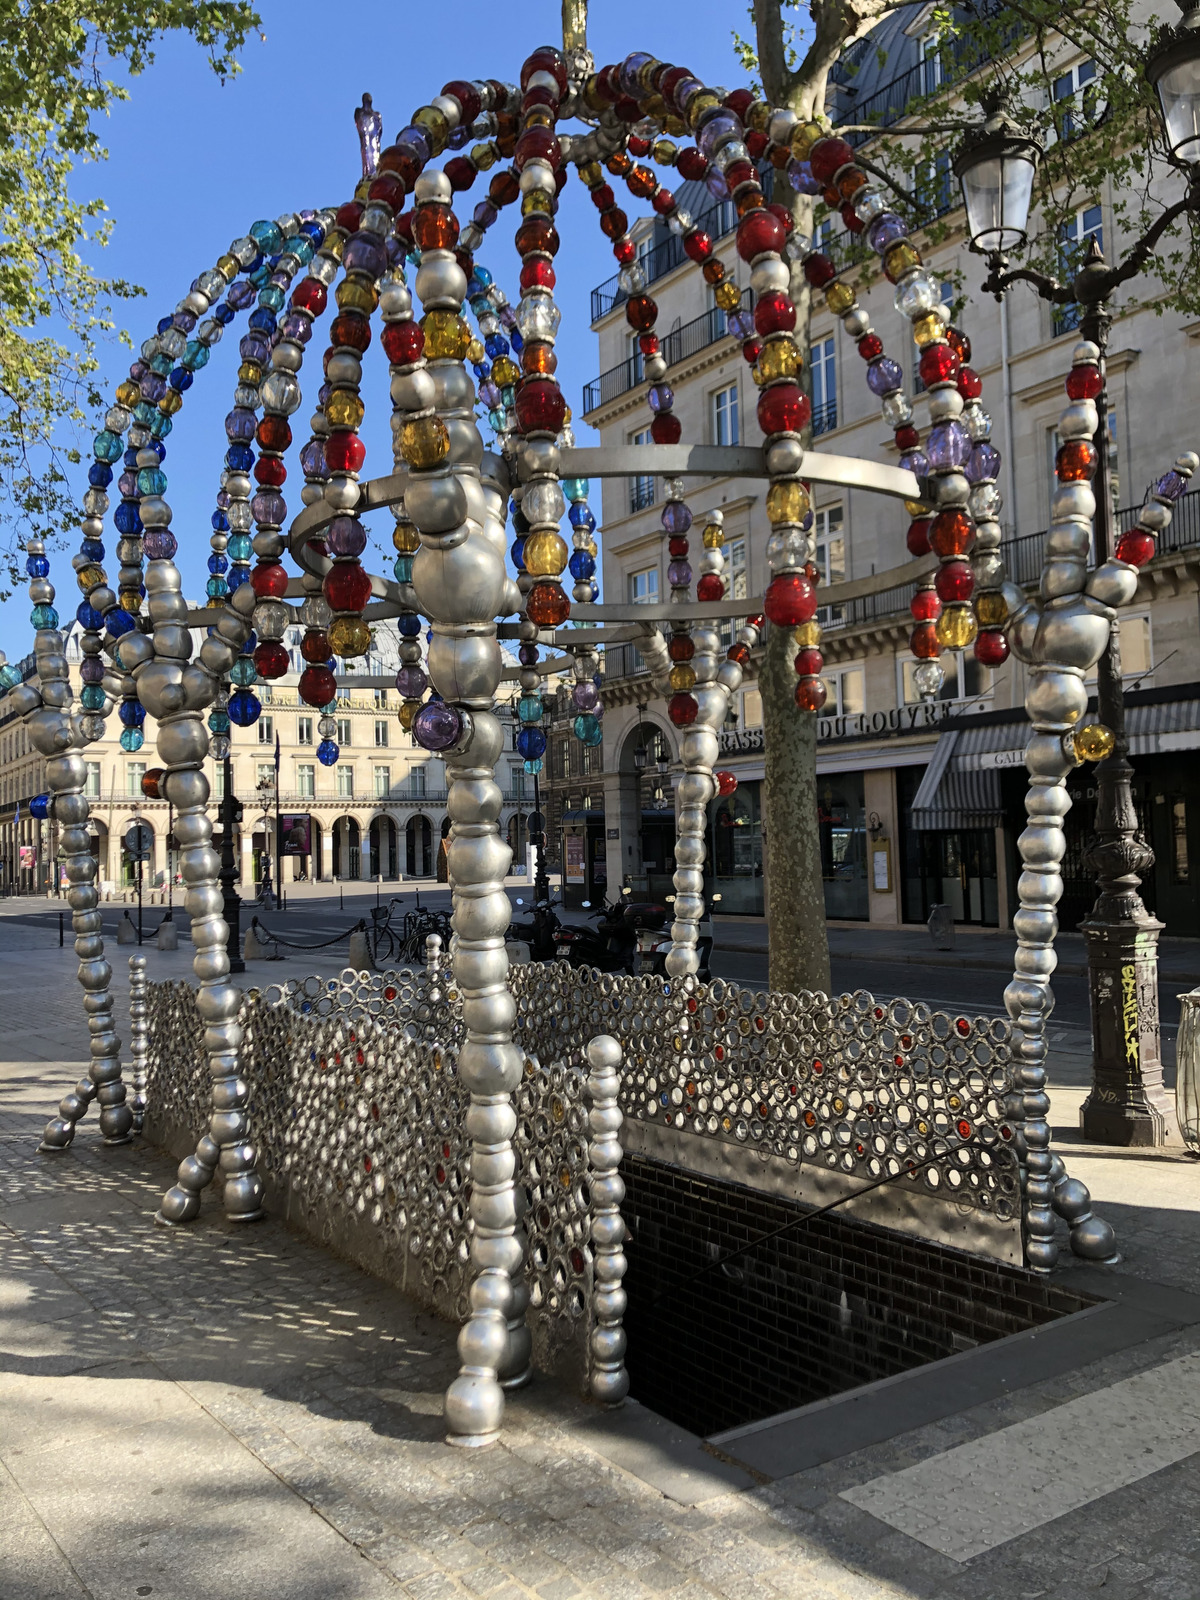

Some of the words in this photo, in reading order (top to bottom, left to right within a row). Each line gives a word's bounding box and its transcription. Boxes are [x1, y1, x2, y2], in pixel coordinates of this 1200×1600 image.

[717, 728, 764, 752] RASS
[820, 716, 847, 738] DU
[854, 701, 953, 733] LOUVRE
